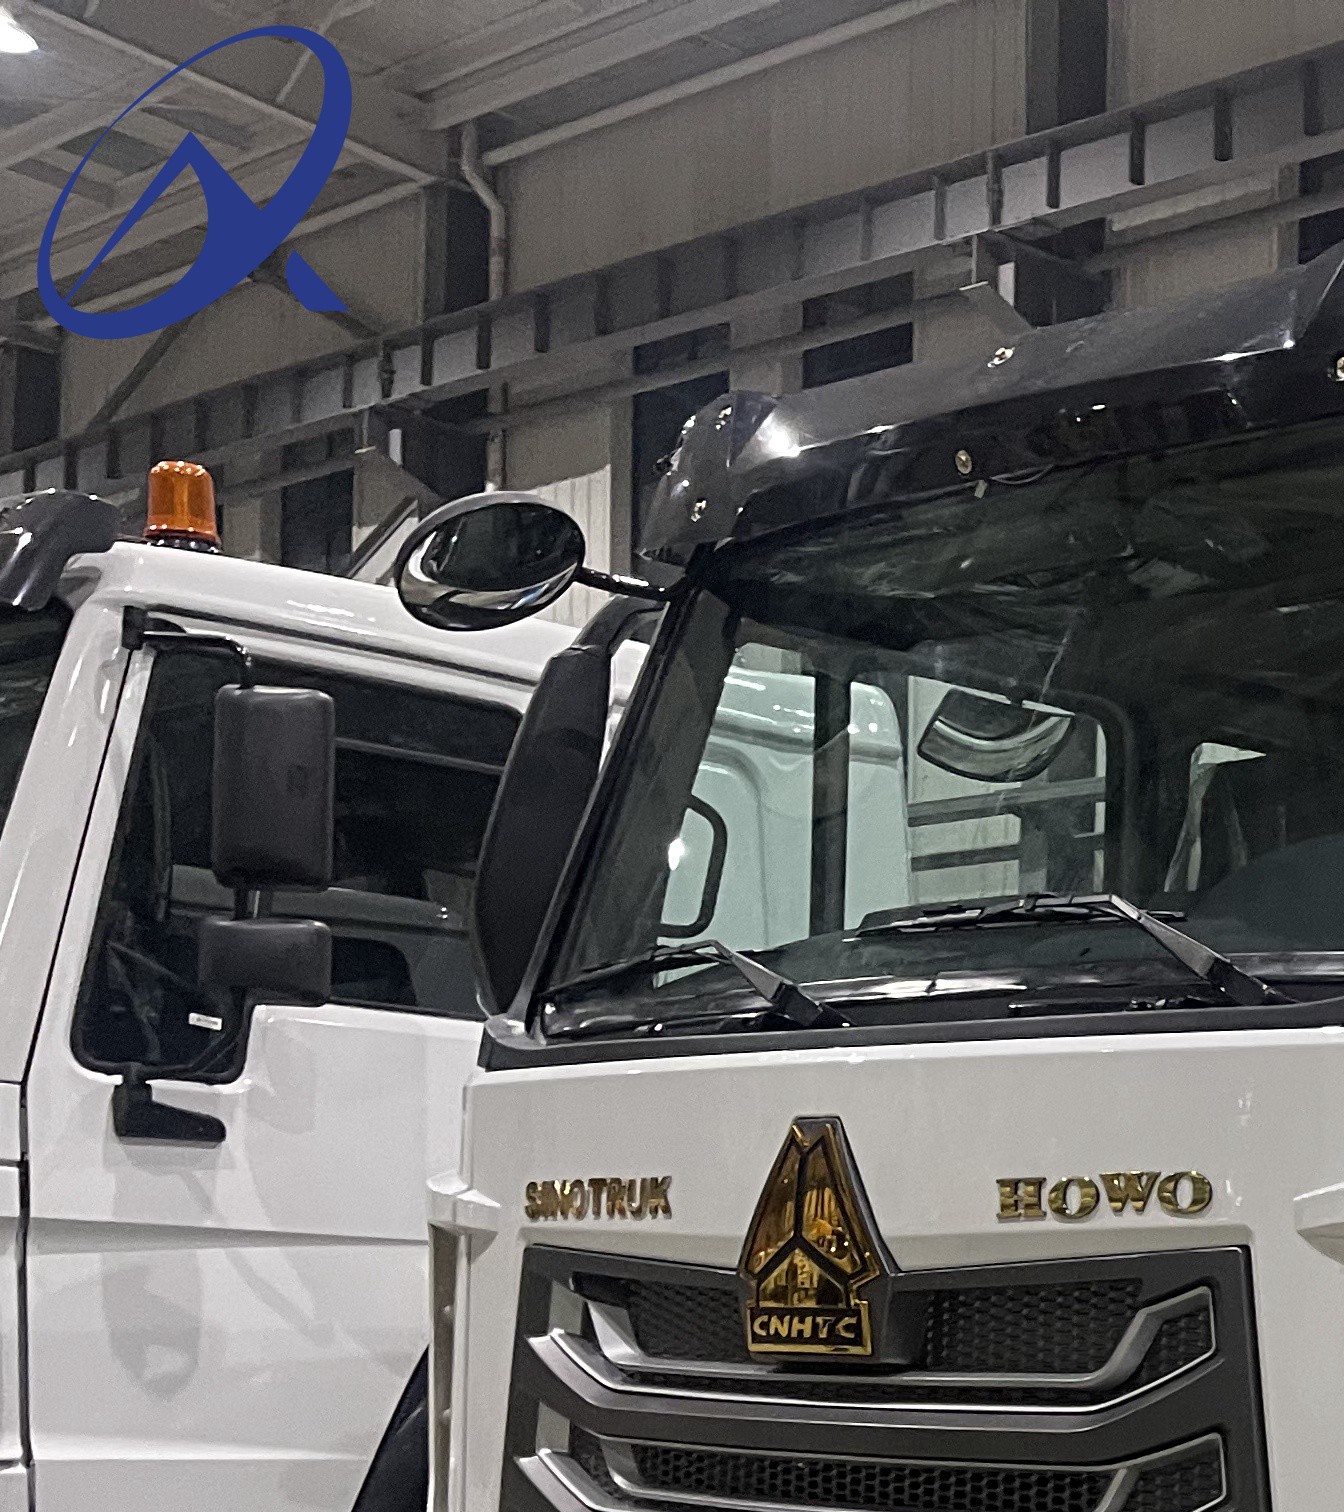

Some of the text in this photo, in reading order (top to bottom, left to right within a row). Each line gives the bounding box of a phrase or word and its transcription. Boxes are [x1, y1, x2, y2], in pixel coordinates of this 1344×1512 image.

[524, 1176, 673, 1221] SINOTRUK
[996, 1170, 1213, 1220] HOWO
[752, 1313, 858, 1339] CNHTC
